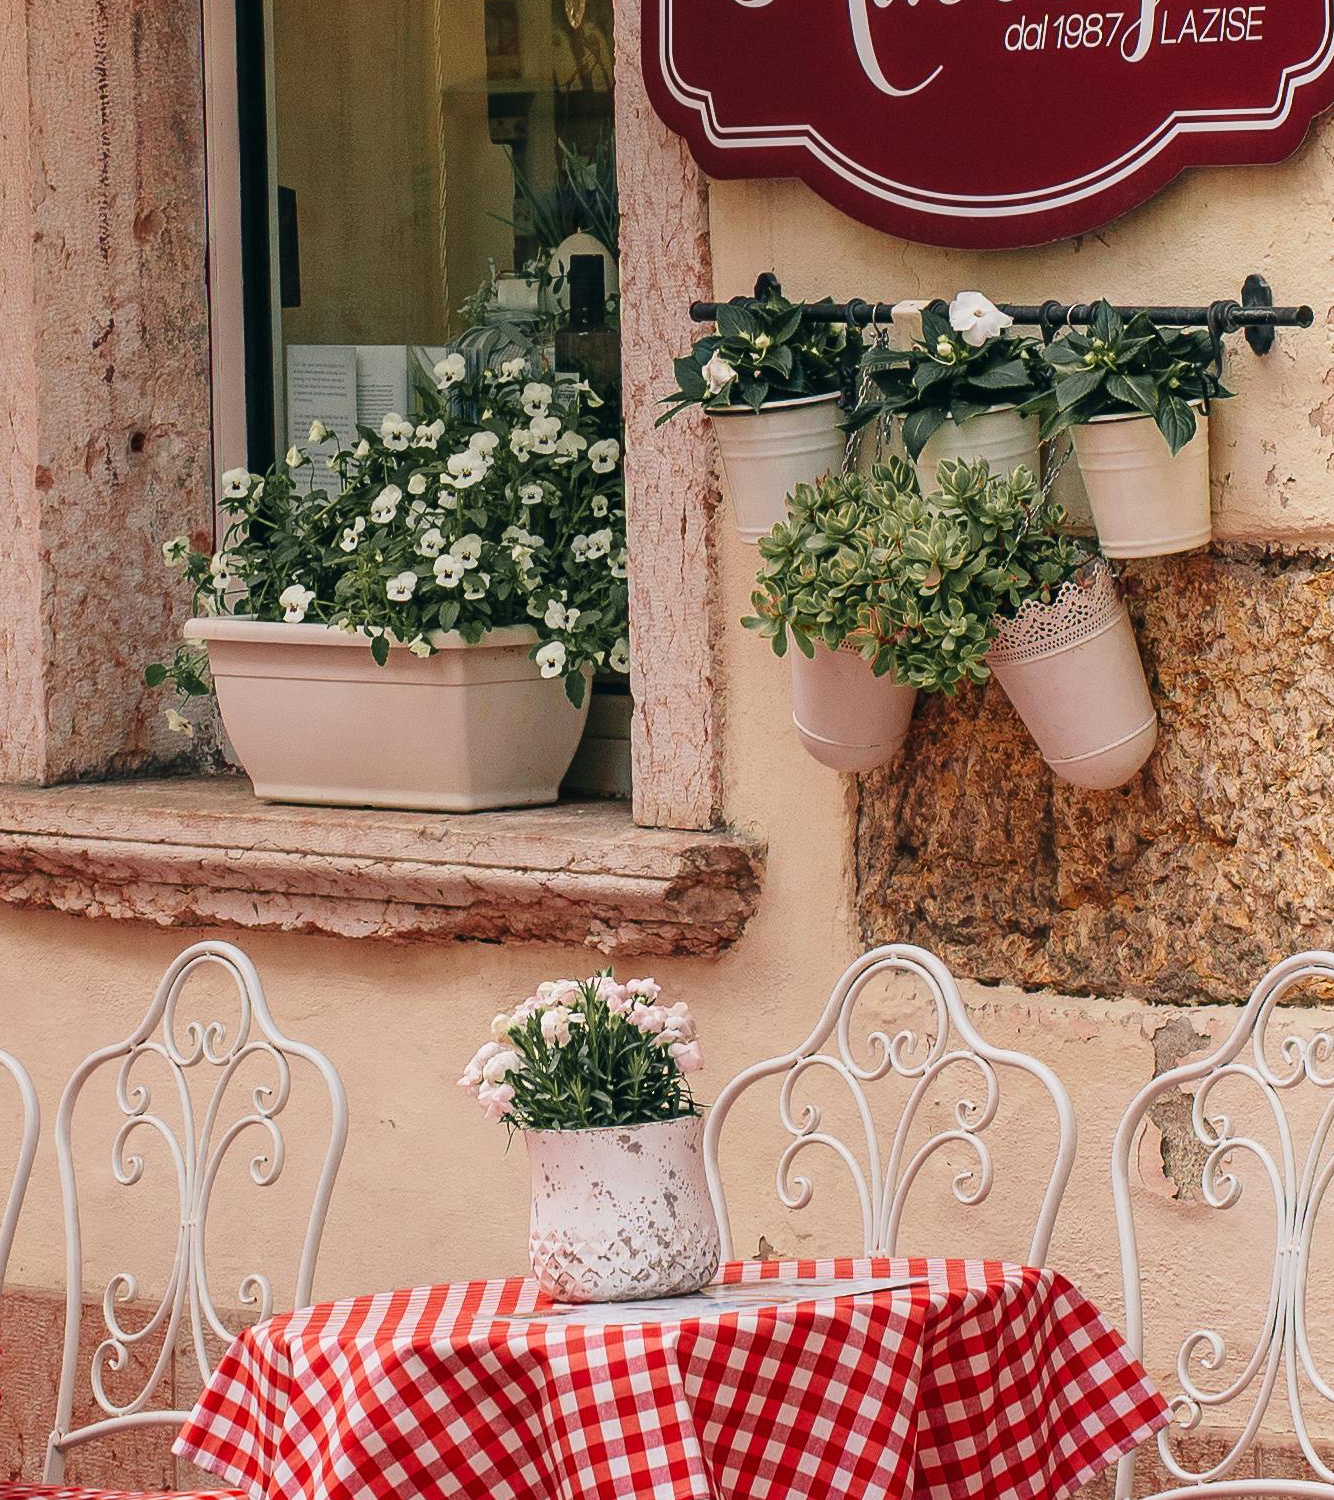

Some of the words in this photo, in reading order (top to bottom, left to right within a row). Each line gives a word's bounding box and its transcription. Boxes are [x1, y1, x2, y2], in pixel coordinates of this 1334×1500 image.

[1004, 13, 1048, 52] dal
[1053, 11, 1122, 50] 1987
[1159, 5, 1267, 46] LAZISE
